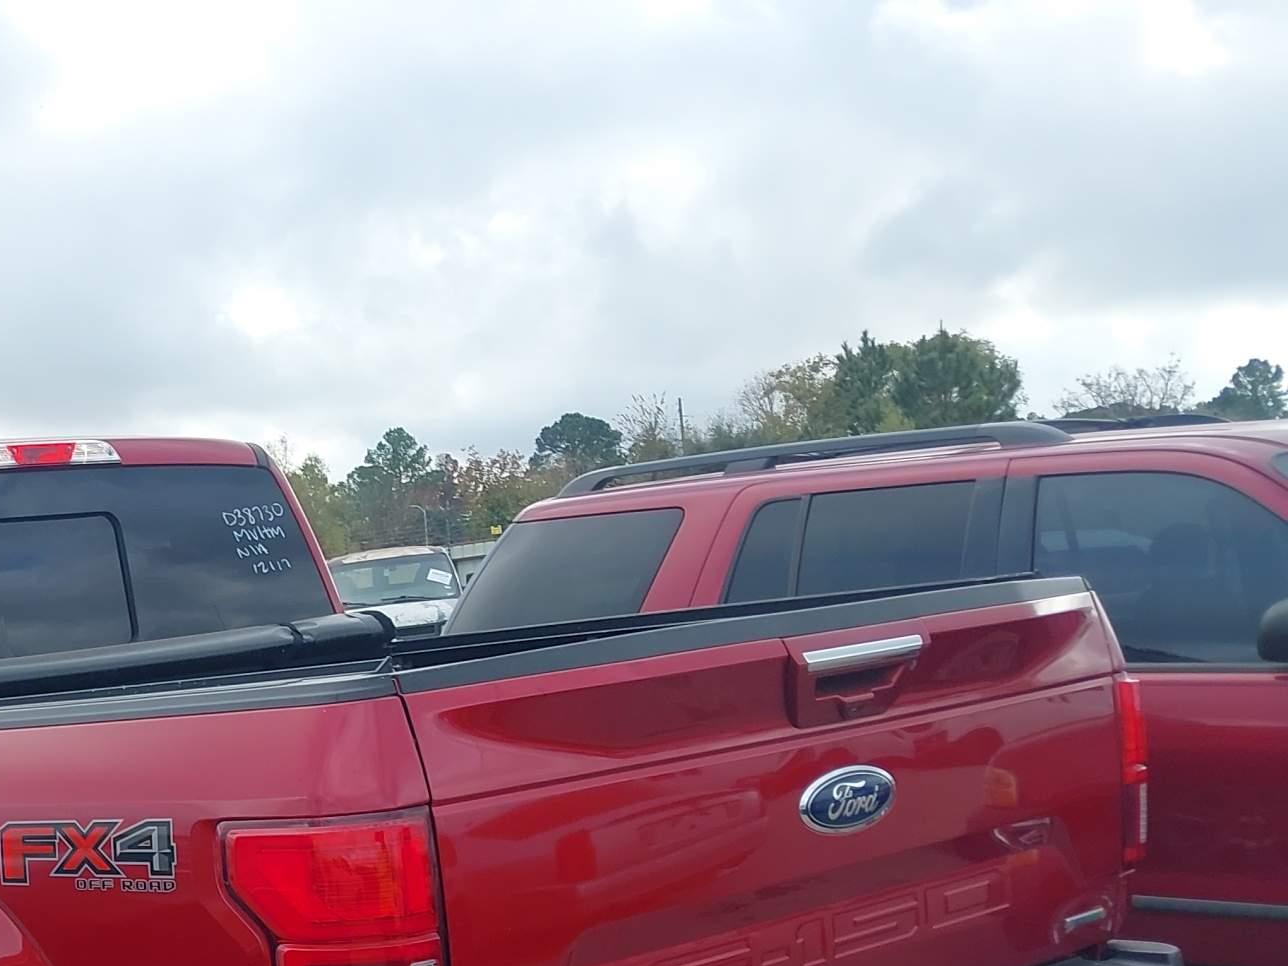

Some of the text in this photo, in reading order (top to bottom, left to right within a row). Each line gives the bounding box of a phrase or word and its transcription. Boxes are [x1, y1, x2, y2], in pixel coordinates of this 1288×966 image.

[828, 780, 879, 820] Ford
[75, 878, 177, 893] OFF ROAD
